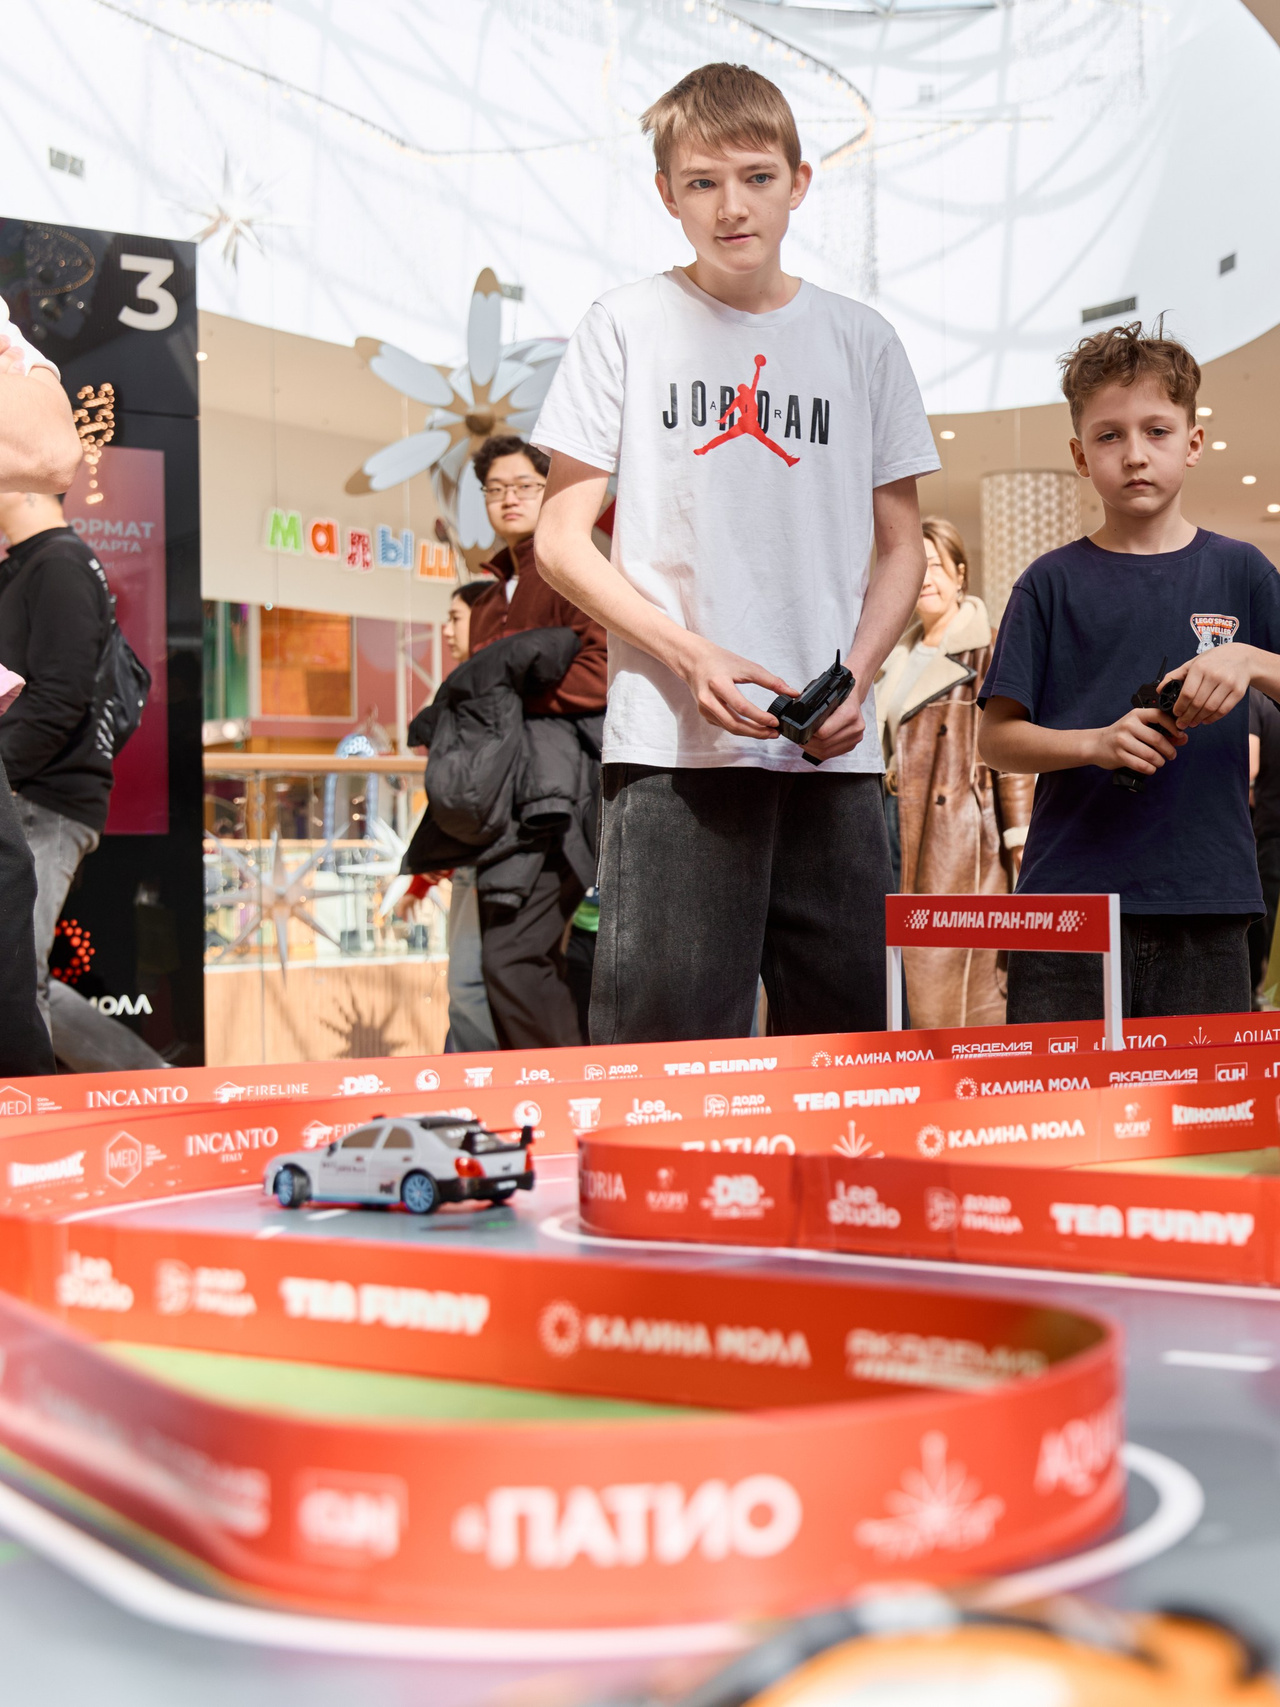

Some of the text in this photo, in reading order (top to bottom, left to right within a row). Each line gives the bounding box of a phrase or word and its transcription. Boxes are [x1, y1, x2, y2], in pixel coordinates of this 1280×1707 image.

[117, 253, 178, 331] 3
[662, 380, 830, 445] JORDAN
[68, 517, 156, 539] ОРМАТ
[267, 508, 458, 582] малыш
[932, 911, 1054, 930] КАЛИНА ГРАН-ПРИ
[951, 1041, 1033, 1054] АКАДЕМИЯ
[1101, 1034, 1167, 1051] ТИО
[834, 1049, 934, 1067] КАЛИНА МОЛЛ
[521, 1067, 549, 1081] Lee
[1109, 1068, 1198, 1083] АКАДЕМИЯ
[86, 1085, 189, 1109] INCANTO
[247, 1083, 310, 1096] FIRELINE
[981, 1076, 1091, 1097] КАЛИНА МОЛЛ
[633, 1098, 666, 1114] Lee
[793, 1090, 840, 1112] TEA
[1172, 1099, 1254, 1125] КИНОМАКС
[186, 1126, 279, 1157] INCANTO
[947, 1119, 1085, 1149] КАЛИНА МОЛЛ
[109, 1147, 139, 1168] MED
[1050, 1202, 1124, 1239] TEA
[487, 1473, 803, 1570] ПАТИО
